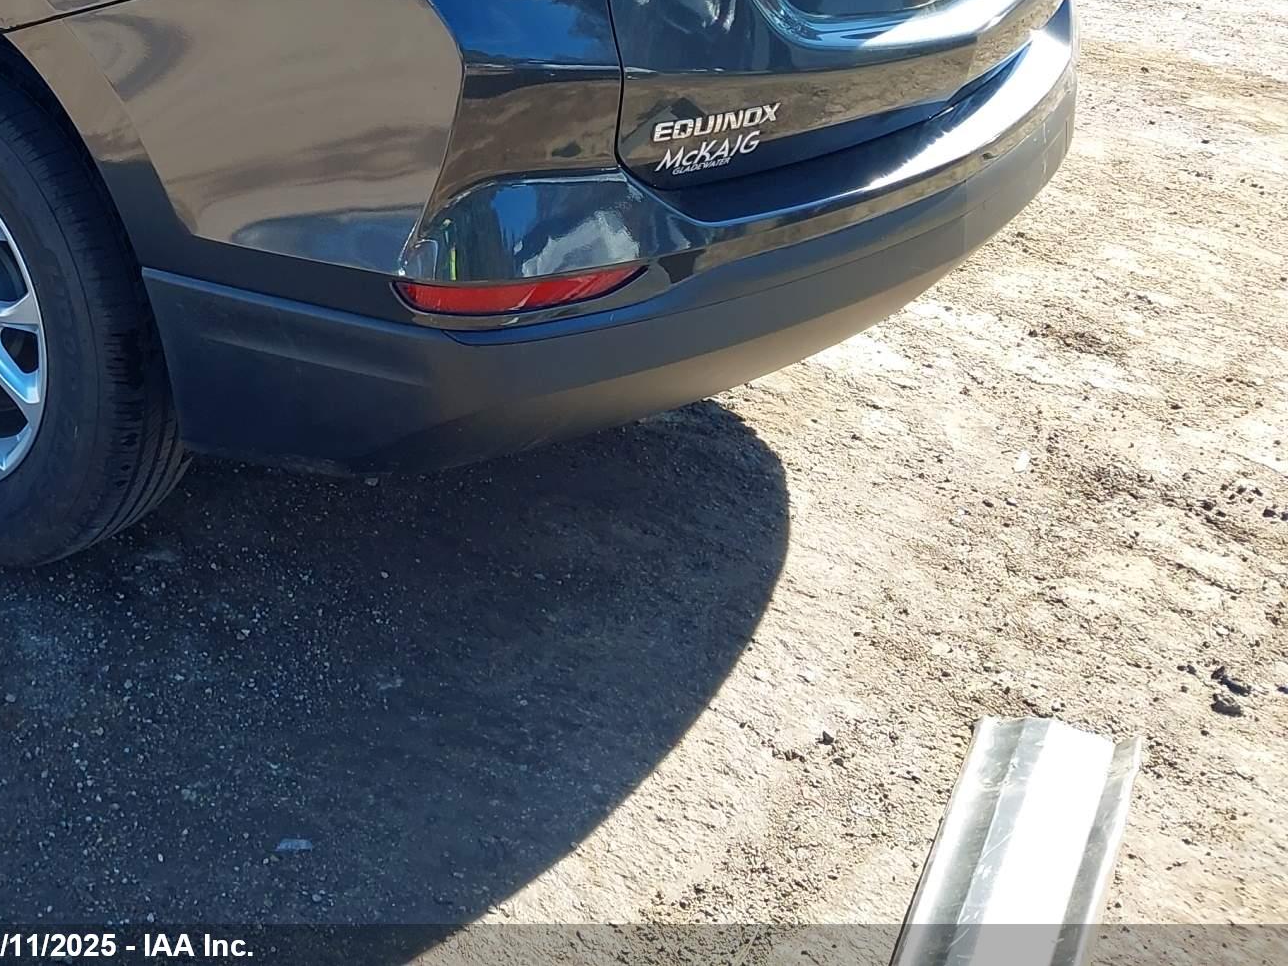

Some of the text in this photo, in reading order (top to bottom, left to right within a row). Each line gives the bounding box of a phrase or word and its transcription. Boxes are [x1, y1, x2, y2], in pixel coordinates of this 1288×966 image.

[653, 102, 781, 143] EQUINOX
[655, 130, 761, 172] McKAIG
[671, 156, 731, 176] GLADEWATER
